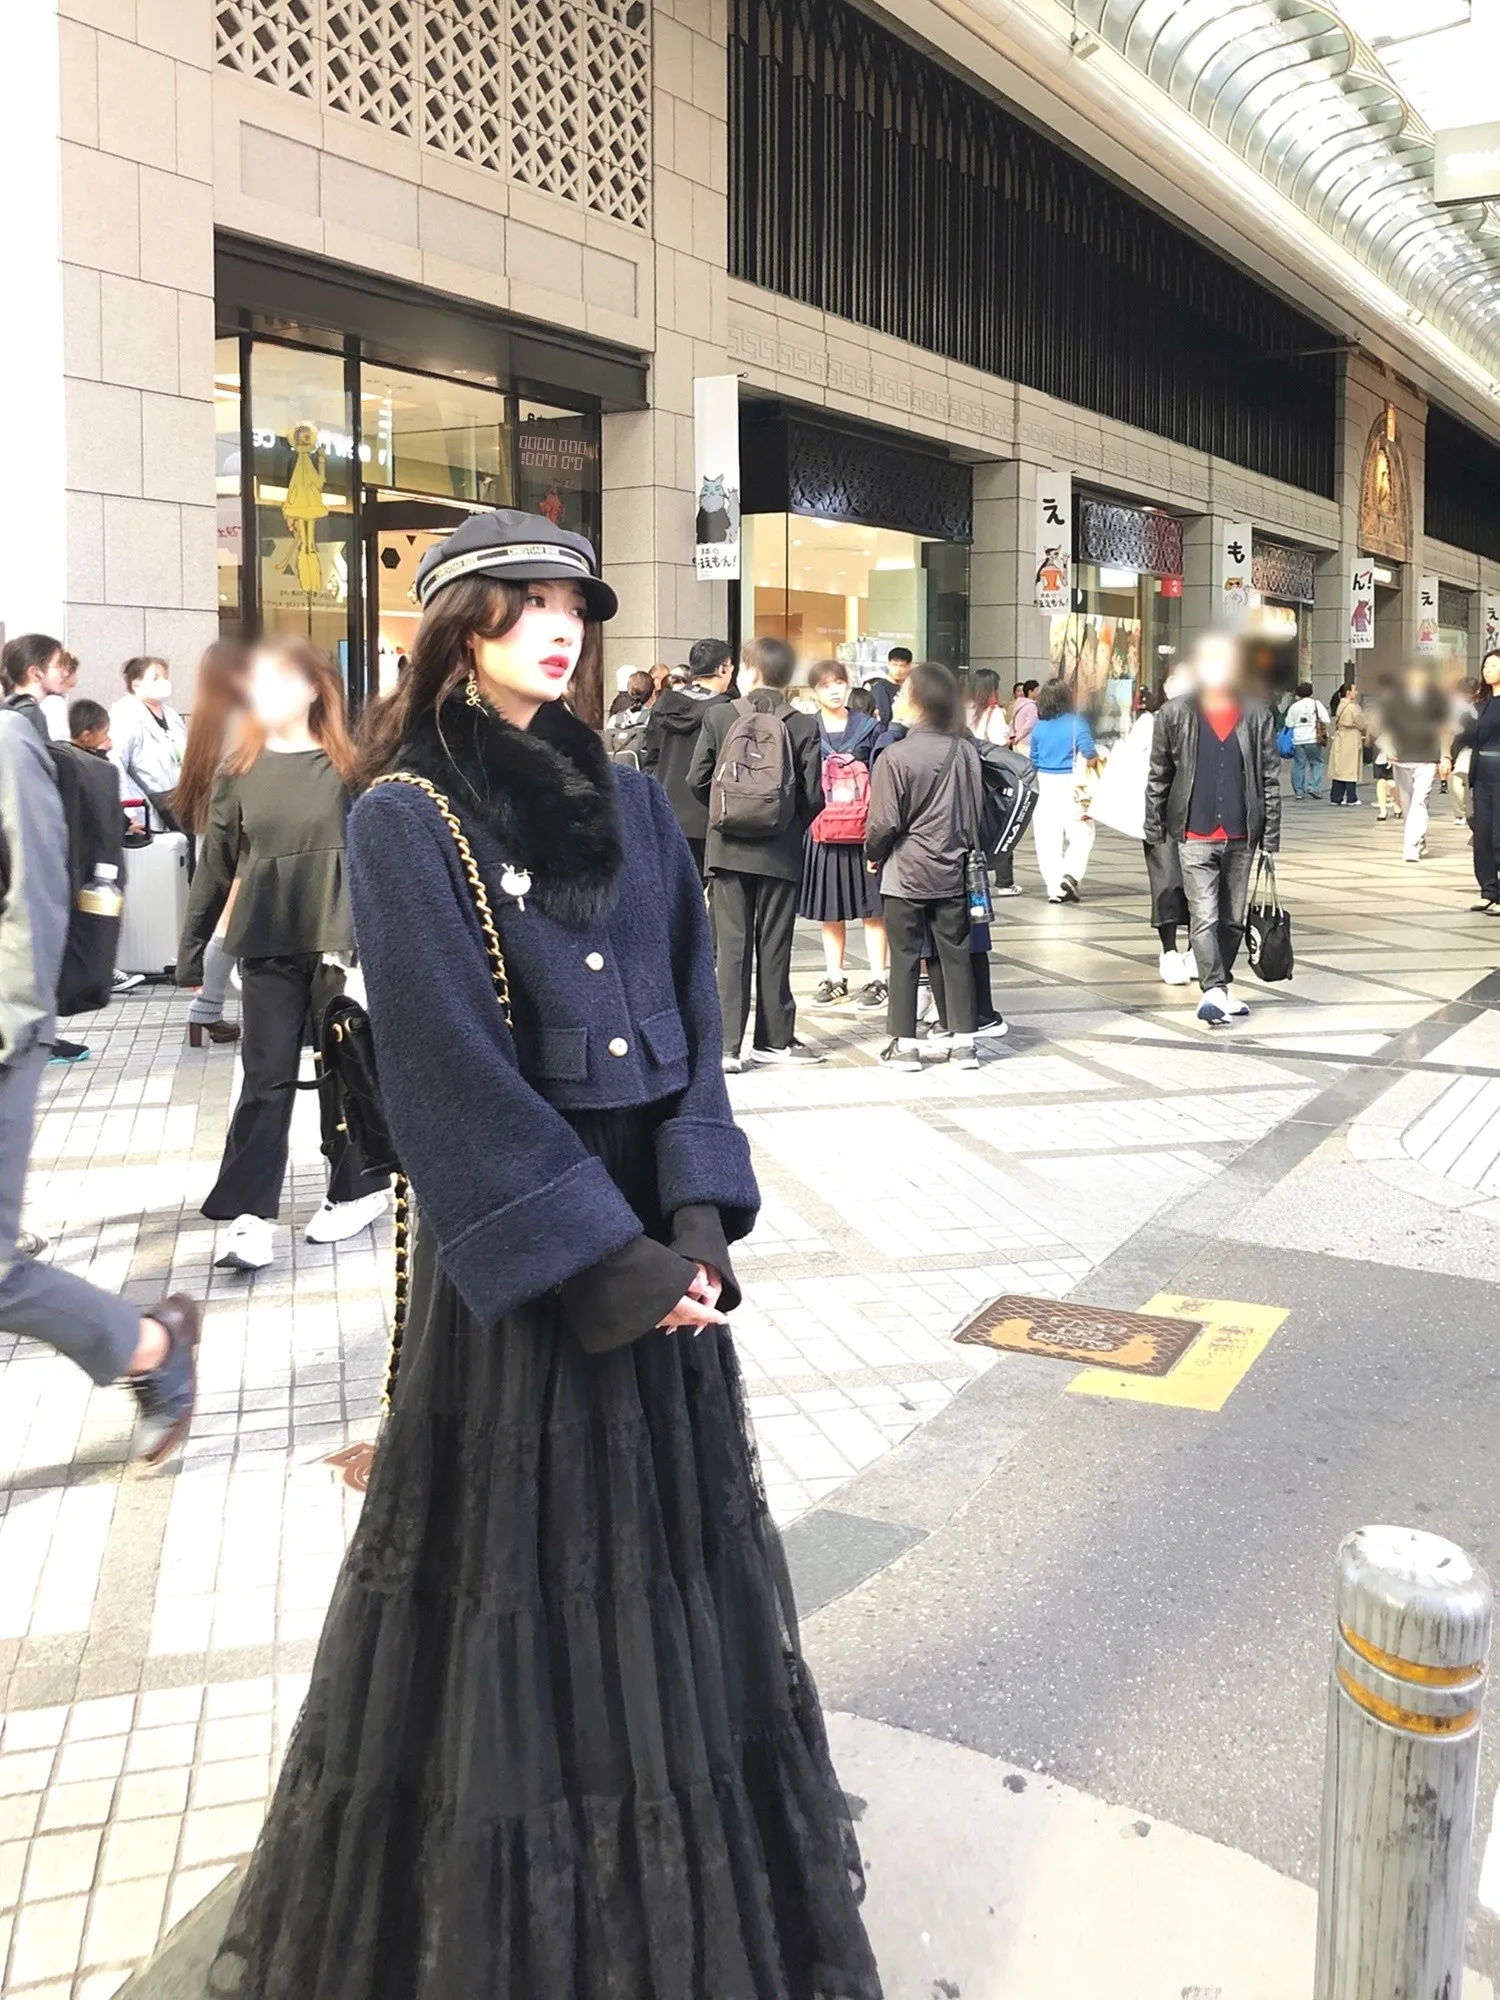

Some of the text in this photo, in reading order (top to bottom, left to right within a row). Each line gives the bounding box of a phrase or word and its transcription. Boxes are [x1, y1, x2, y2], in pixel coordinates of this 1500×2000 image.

[1042, 498, 1065, 525] え
[1227, 541, 1245, 564] も
[1421, 591, 1433, 606] え
[1487, 607, 1500, 620] え
[1001, 824, 1021, 852] FILA
